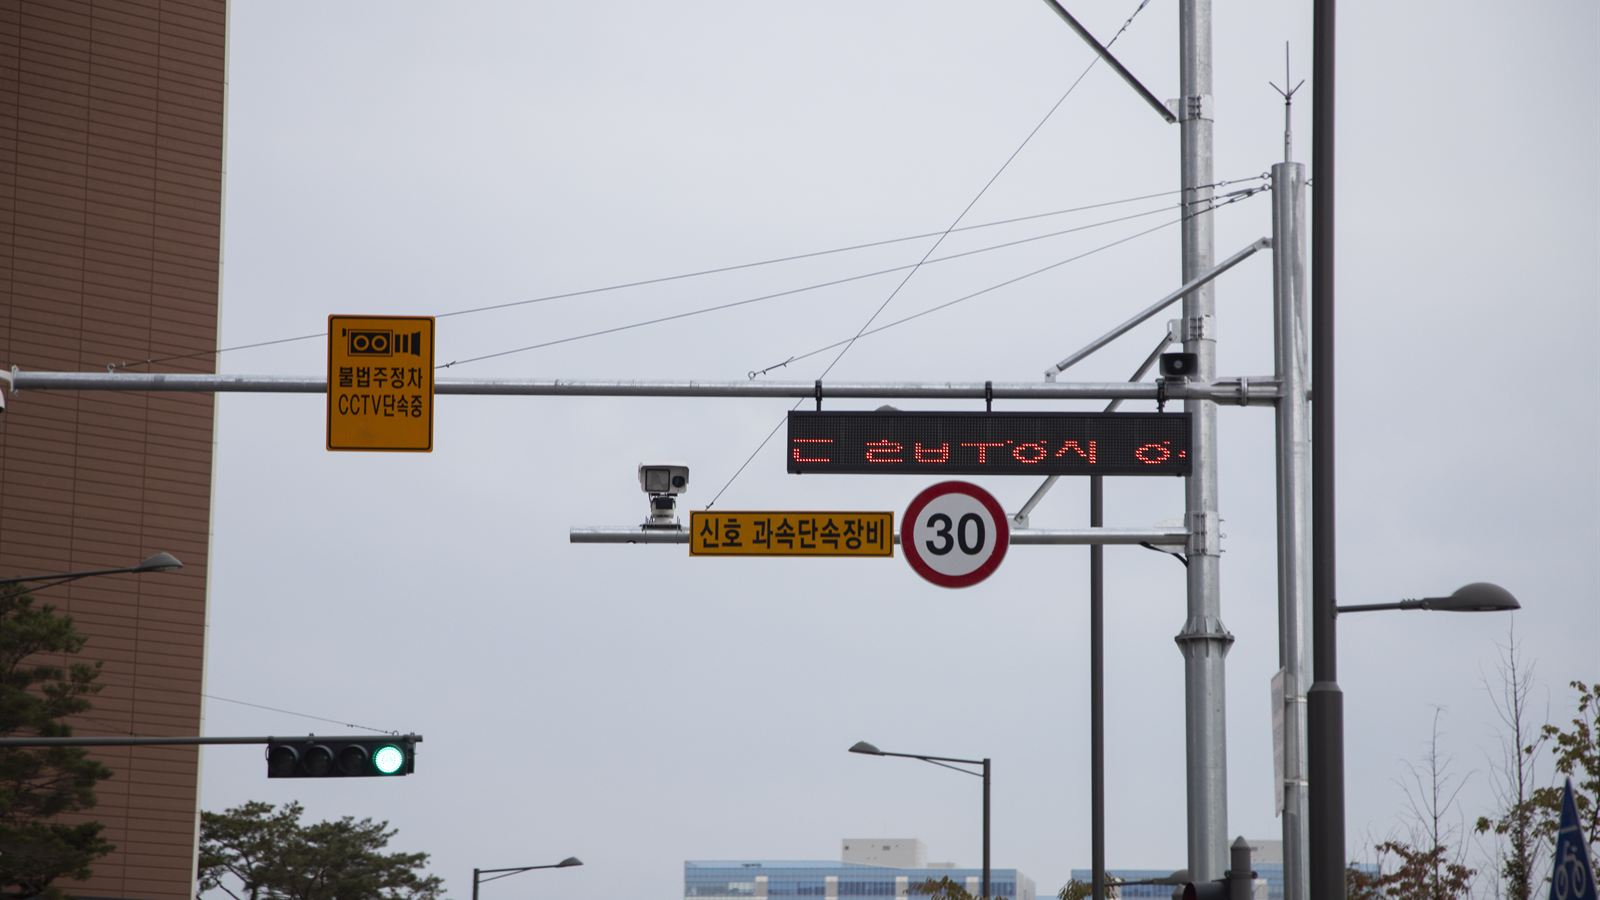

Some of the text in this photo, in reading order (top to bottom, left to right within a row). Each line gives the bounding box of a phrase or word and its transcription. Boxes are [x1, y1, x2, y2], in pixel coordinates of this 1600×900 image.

[339, 366, 423, 389] 불법주정차
[338, 394, 422, 418] CCTV단속중
[700, 517, 885, 550] 신호 과속단속장비
[925, 512, 986, 556] 30
